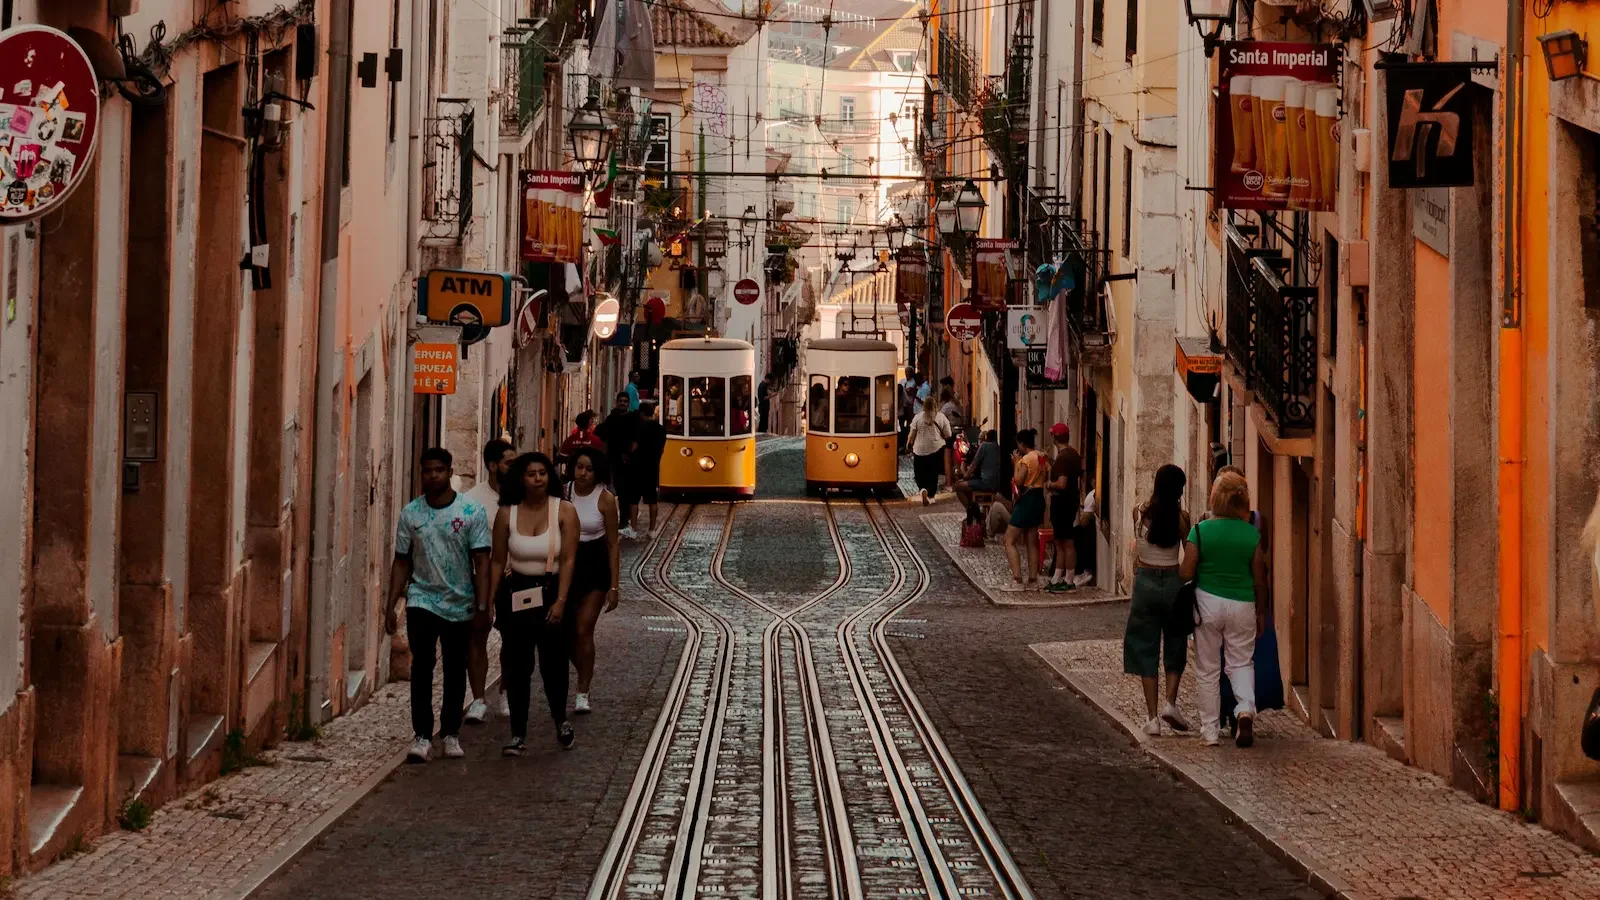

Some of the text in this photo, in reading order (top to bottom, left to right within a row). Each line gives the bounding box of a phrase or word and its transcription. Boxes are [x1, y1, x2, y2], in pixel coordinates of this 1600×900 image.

[1229, 48, 1328, 70] Santa Imperial
[526, 173, 581, 186] Santa Imperial
[976, 241, 1019, 250] Santa Imperial
[440, 276, 492, 297] ATM
